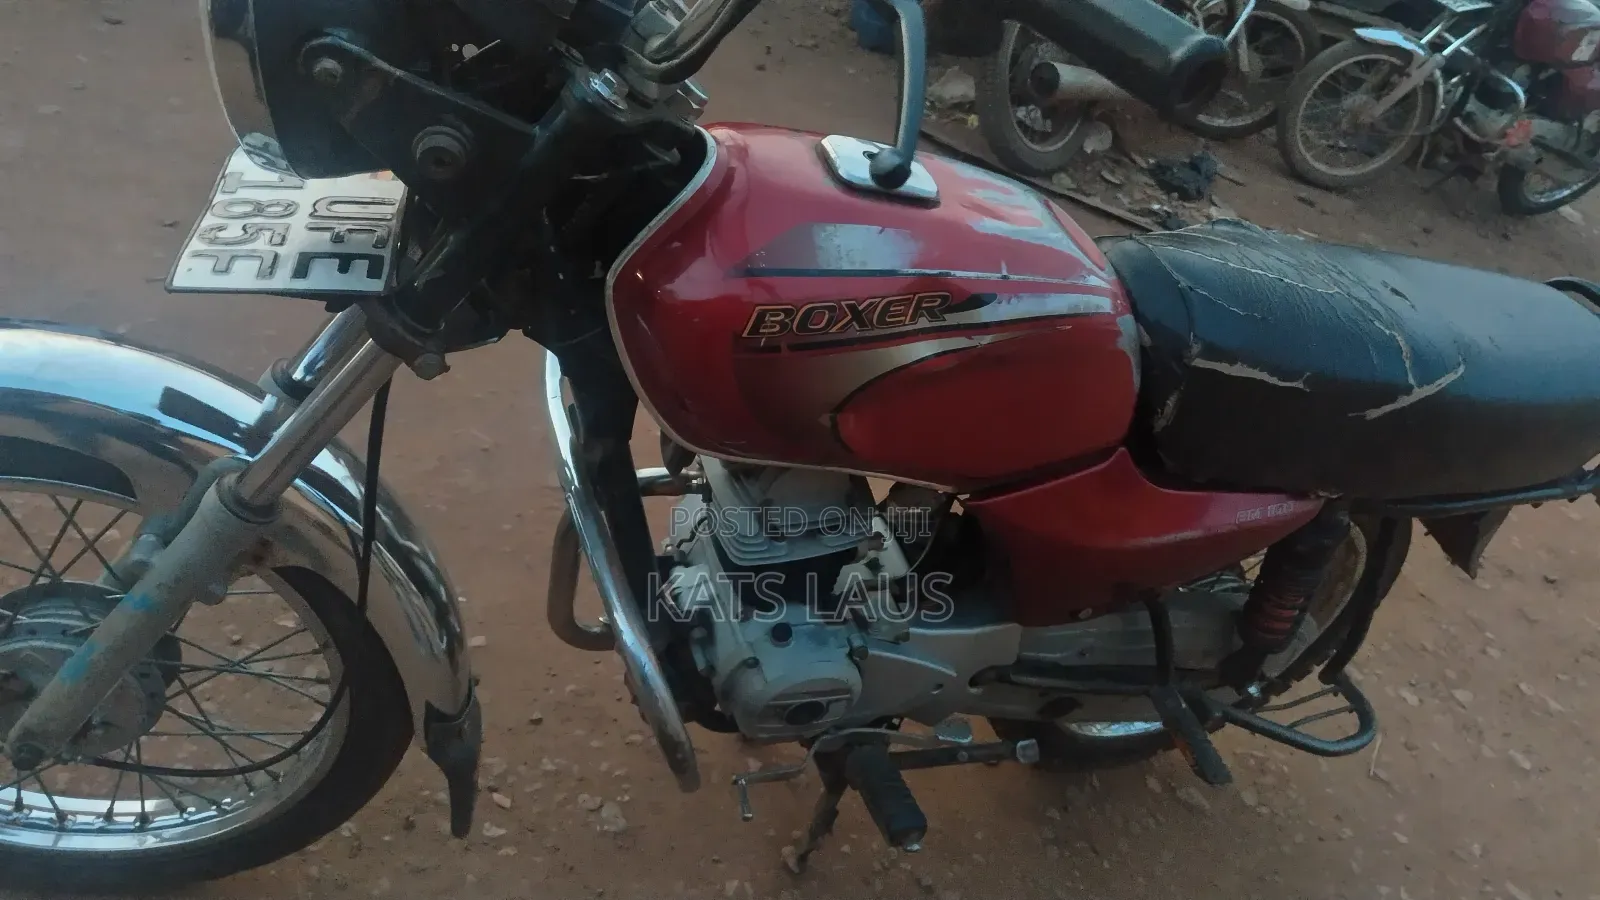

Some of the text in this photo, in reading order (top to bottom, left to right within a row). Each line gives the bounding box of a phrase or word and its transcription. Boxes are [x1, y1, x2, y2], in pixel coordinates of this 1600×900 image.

[189, 172, 304, 280] 185F
[291, 197, 398, 280] UFE
[742, 292, 952, 338] BOXER
